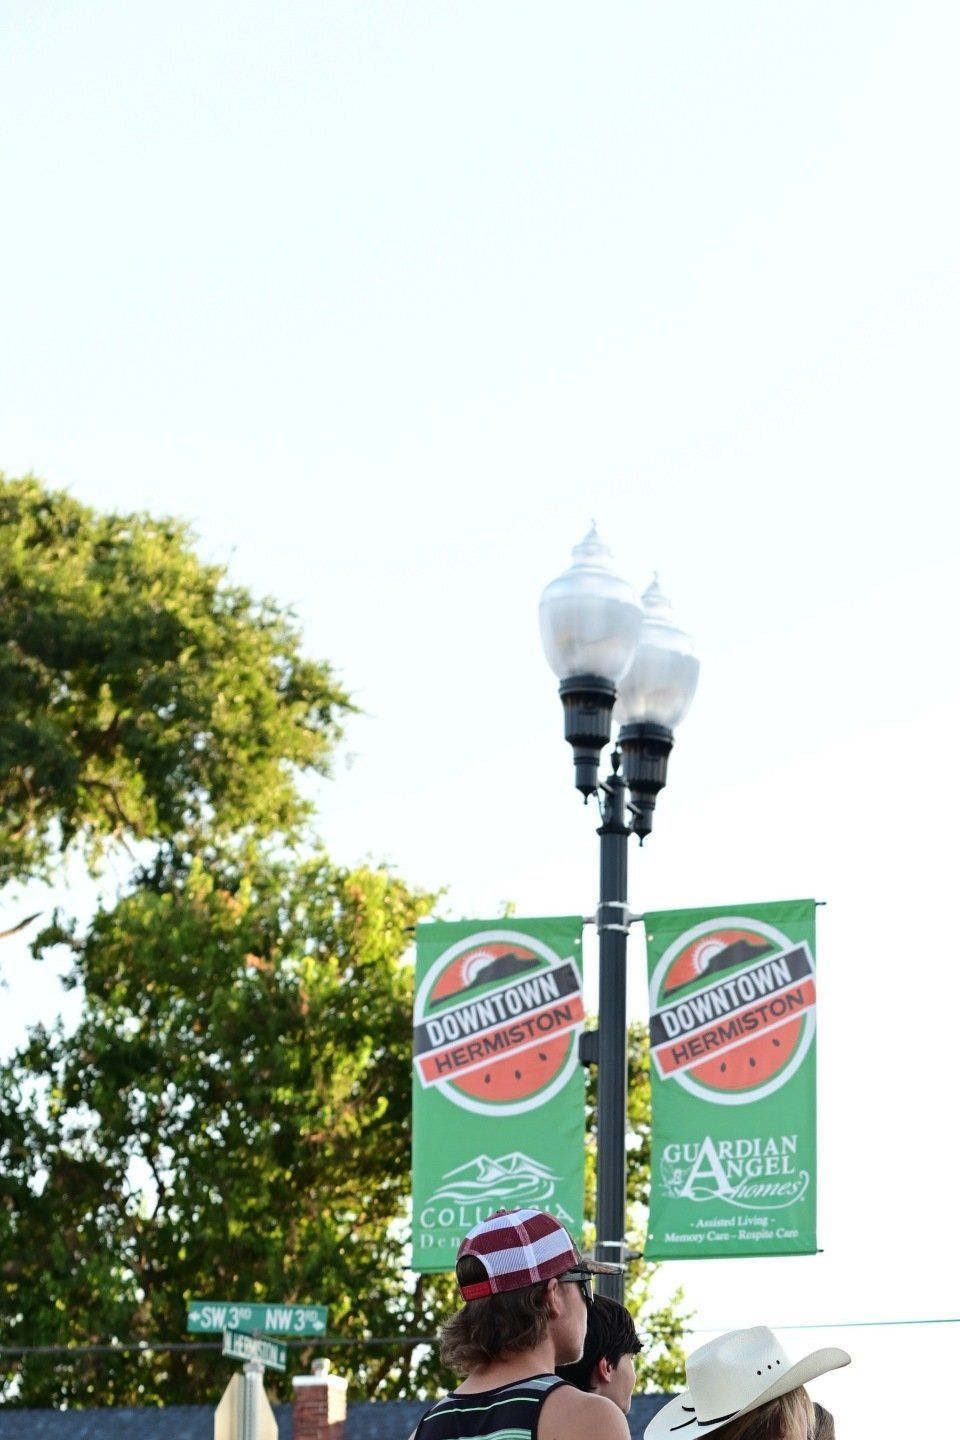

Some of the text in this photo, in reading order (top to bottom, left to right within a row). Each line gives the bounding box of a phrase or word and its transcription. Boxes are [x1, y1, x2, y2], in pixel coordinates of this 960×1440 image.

[426, 973, 560, 1047] DOWNTOWN
[660, 958, 793, 1039] DOWNTOWN
[434, 1005, 573, 1073] HERMISTON
[671, 988, 805, 1065] HERMISTON
[731, 1175, 805, 1200] homes
[420, 1203, 574, 1229] COLUA
[695, 1216, 735, 1228] Assisted
[738, 1215, 769, 1228] Living
[664, 1231, 705, 1244] Memory
[707, 1230, 730, 1242] Care
[738, 1228, 773, 1241] Respite
[776, 1228, 799, 1239] Care
[200, 1306, 318, 1332] SW 3RD NW 3RD
